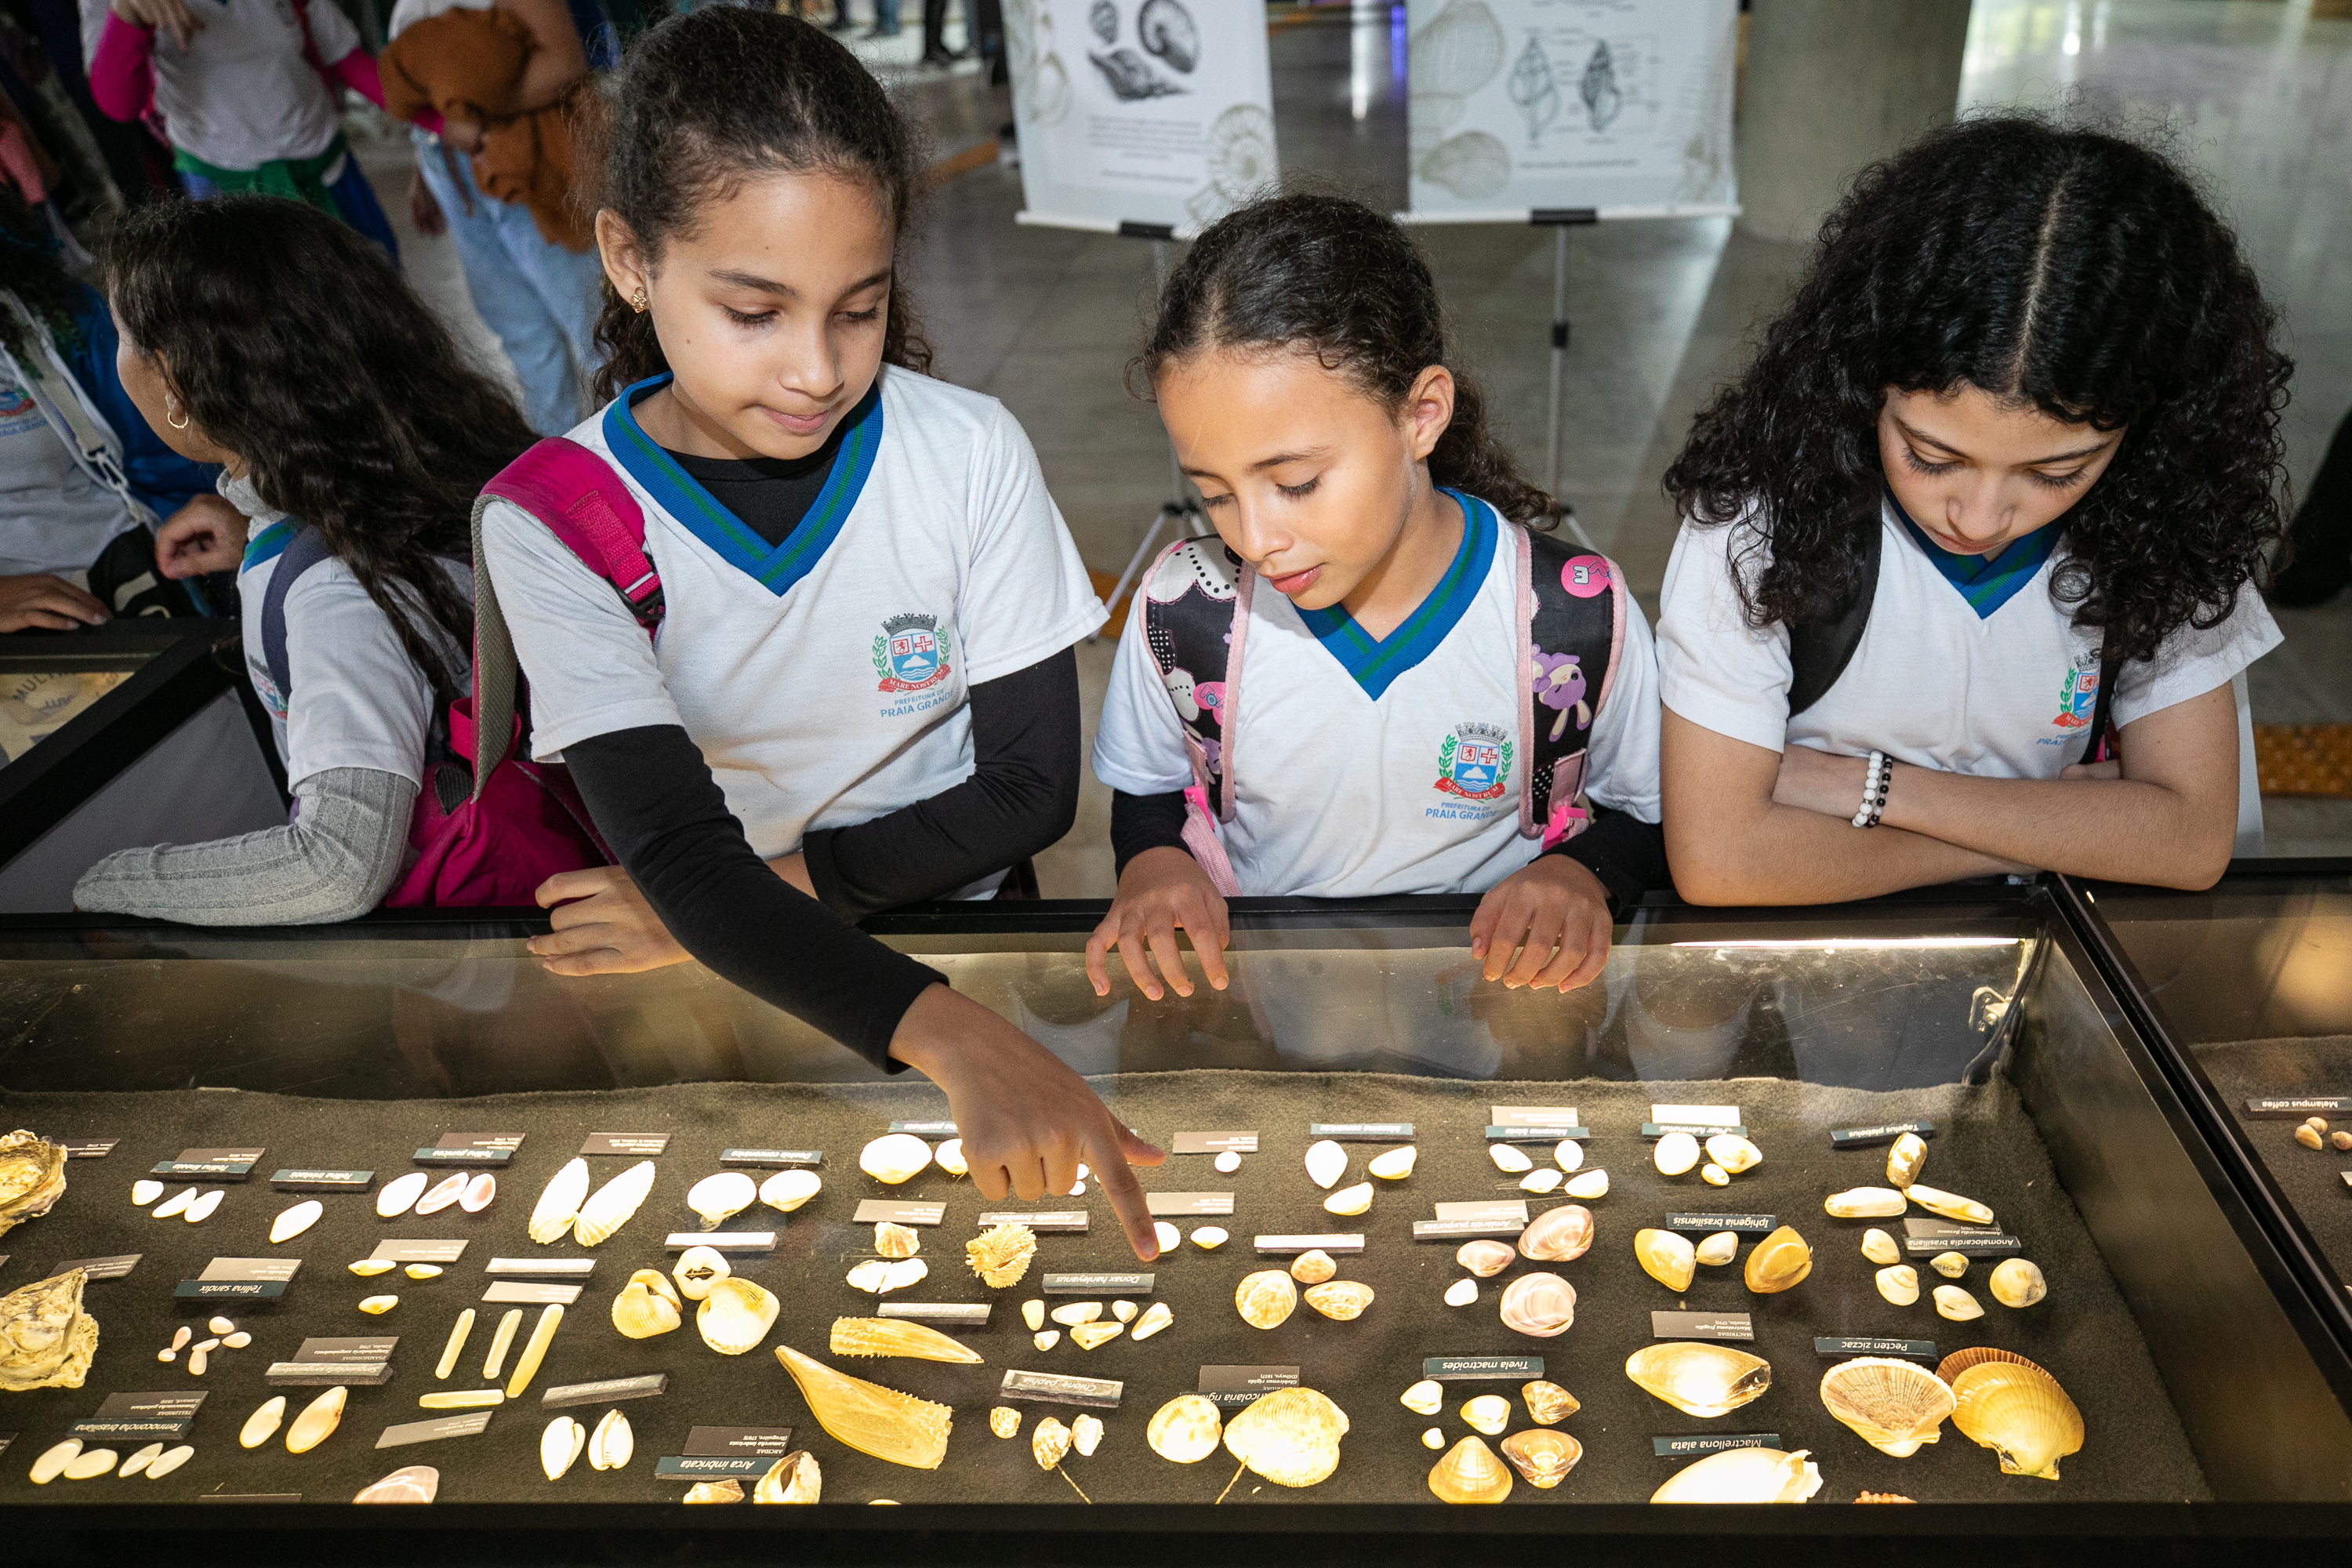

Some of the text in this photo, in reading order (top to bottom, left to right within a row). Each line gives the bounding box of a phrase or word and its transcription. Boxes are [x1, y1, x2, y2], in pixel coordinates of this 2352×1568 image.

[888, 669, 945, 690] MARE NOSTRUM
[880, 688, 954, 717] PRAIA GRANDE
[895, 688, 945, 706] PREFEITURA DE
[1445, 780, 1499, 800] MARE NOSTRUM
[1441, 802, 1481, 811] PREFEITURA
[1425, 808, 1497, 821] PRAIA GRANDE
[2262, 1100, 2339, 1109] Melampus coffea
[1659, 1126, 1705, 1134] fulminatus
[1848, 1123, 1919, 1138] Tagelus plebeius
[1423, 1220, 1511, 1230] Amiantis purpurata
[1673, 1217, 1769, 1229] Iphigenia brasiliensis
[1054, 1274, 1141, 1284] Donax hanleyanus
[198, 1285, 263, 1294] Tellina sandix
[1841, 1341, 1907, 1351] Pecten ziczac
[1442, 1360, 1529, 1371] Tivela mactroides
[565, 1379, 639, 1396] Anadara ovalis
[1022, 1377, 1097, 1392] Chione paphia
[1224, 1392, 1268, 1403] ricolaria
[74, 1423, 183, 1432] Temnoconcha brasiliana
[1671, 1439, 1762, 1451] Mactrellona alata
[680, 1460, 756, 1470] Arca imbricata
